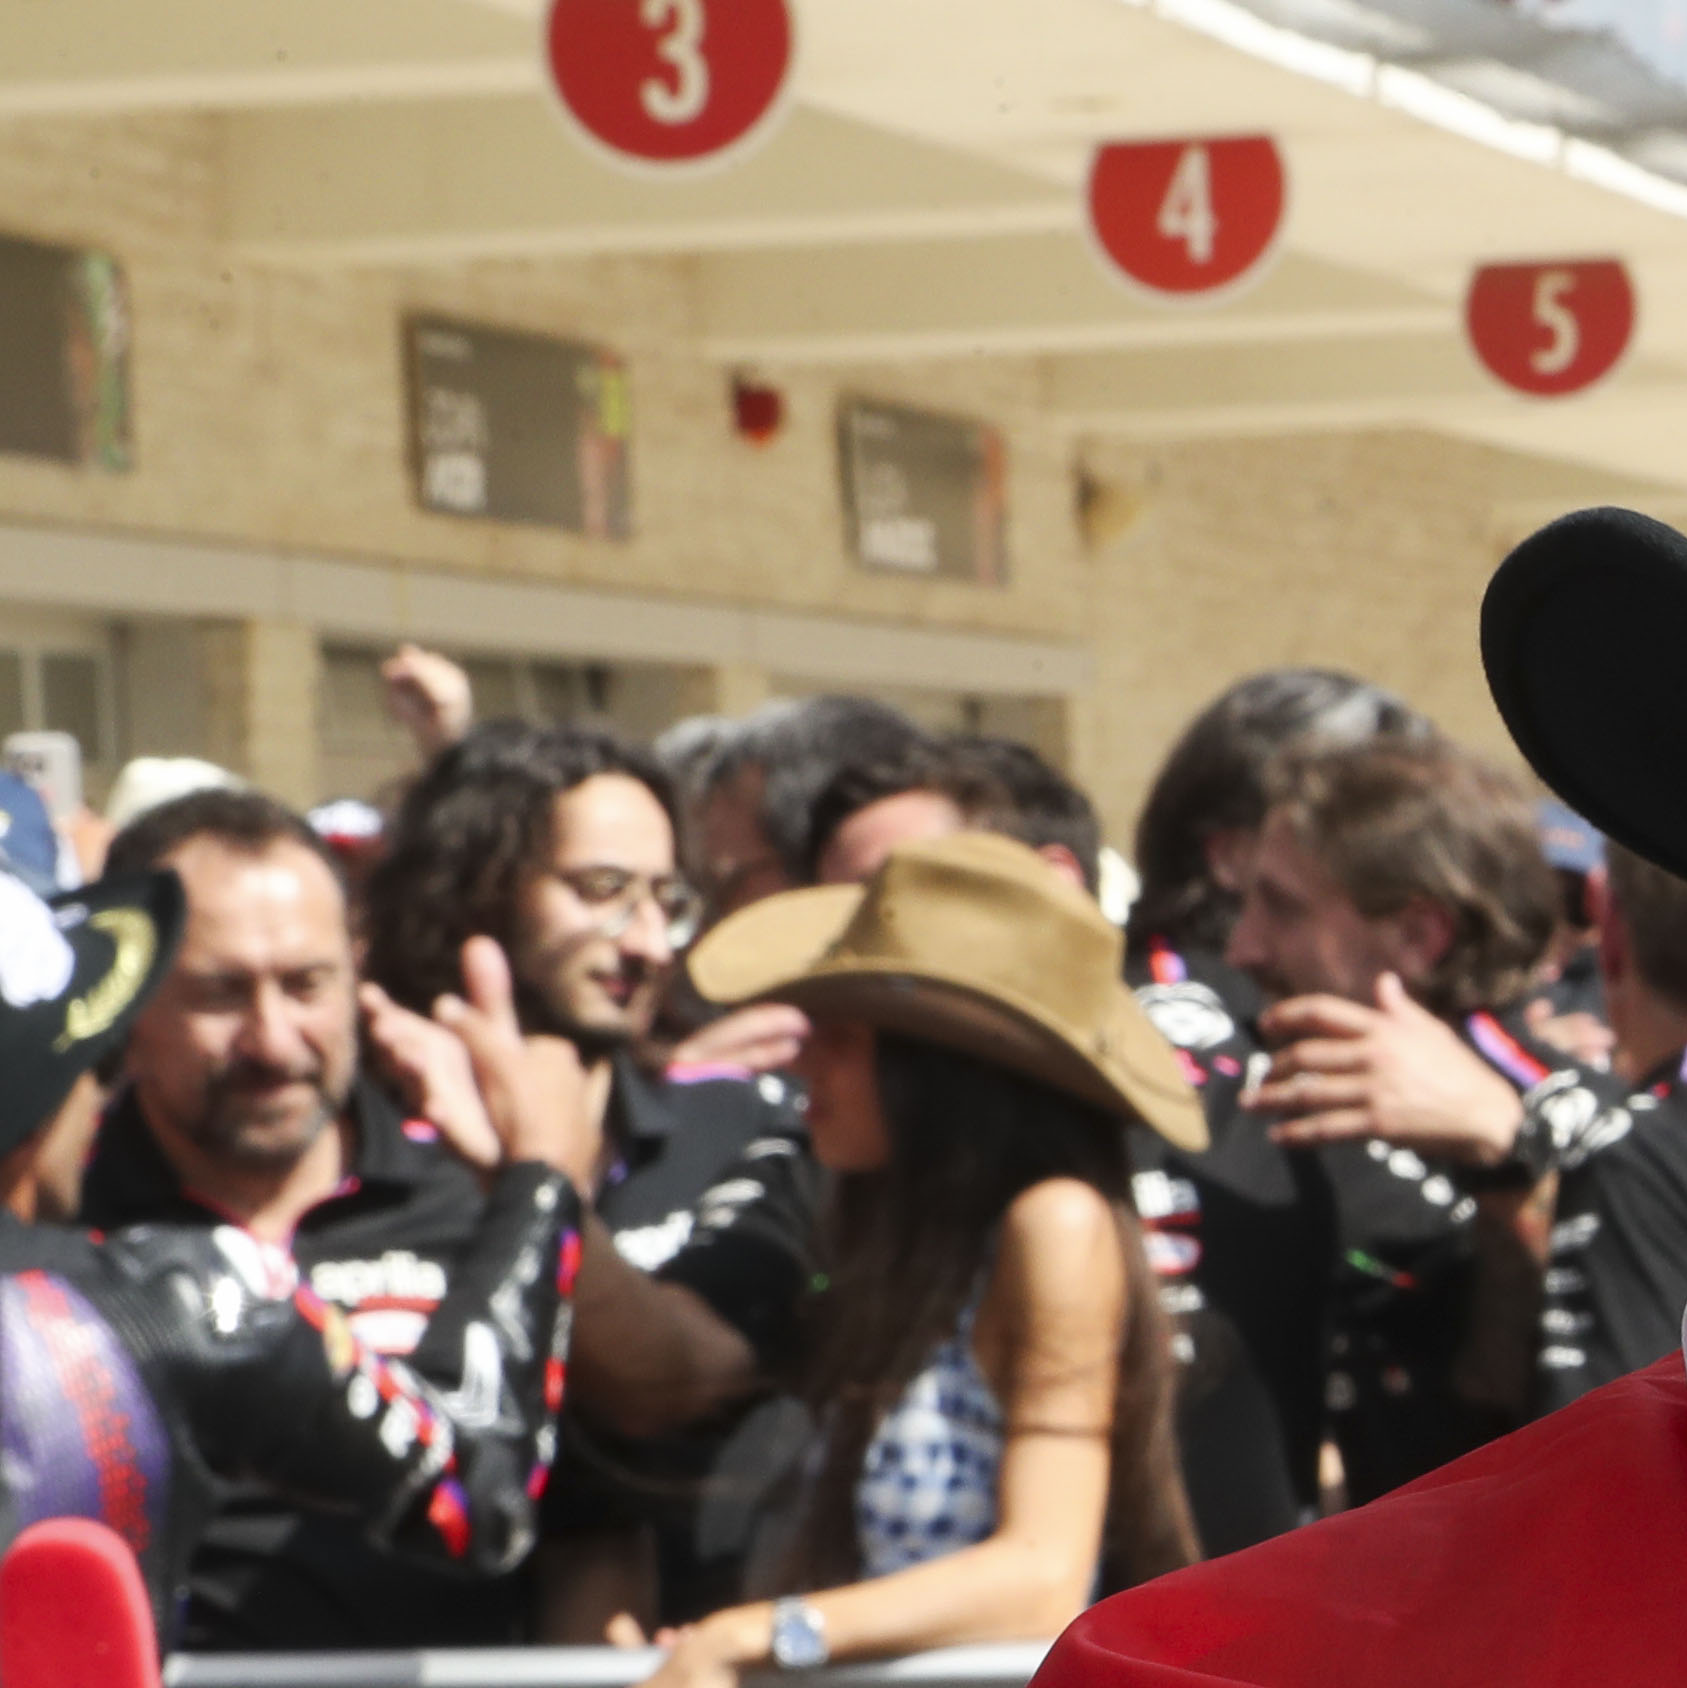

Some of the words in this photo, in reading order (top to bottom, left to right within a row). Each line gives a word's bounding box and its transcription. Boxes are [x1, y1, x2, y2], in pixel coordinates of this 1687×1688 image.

[640, 0, 711, 125] 3
[1155, 143, 1219, 266] 4
[1529, 270, 1581, 376] 5
